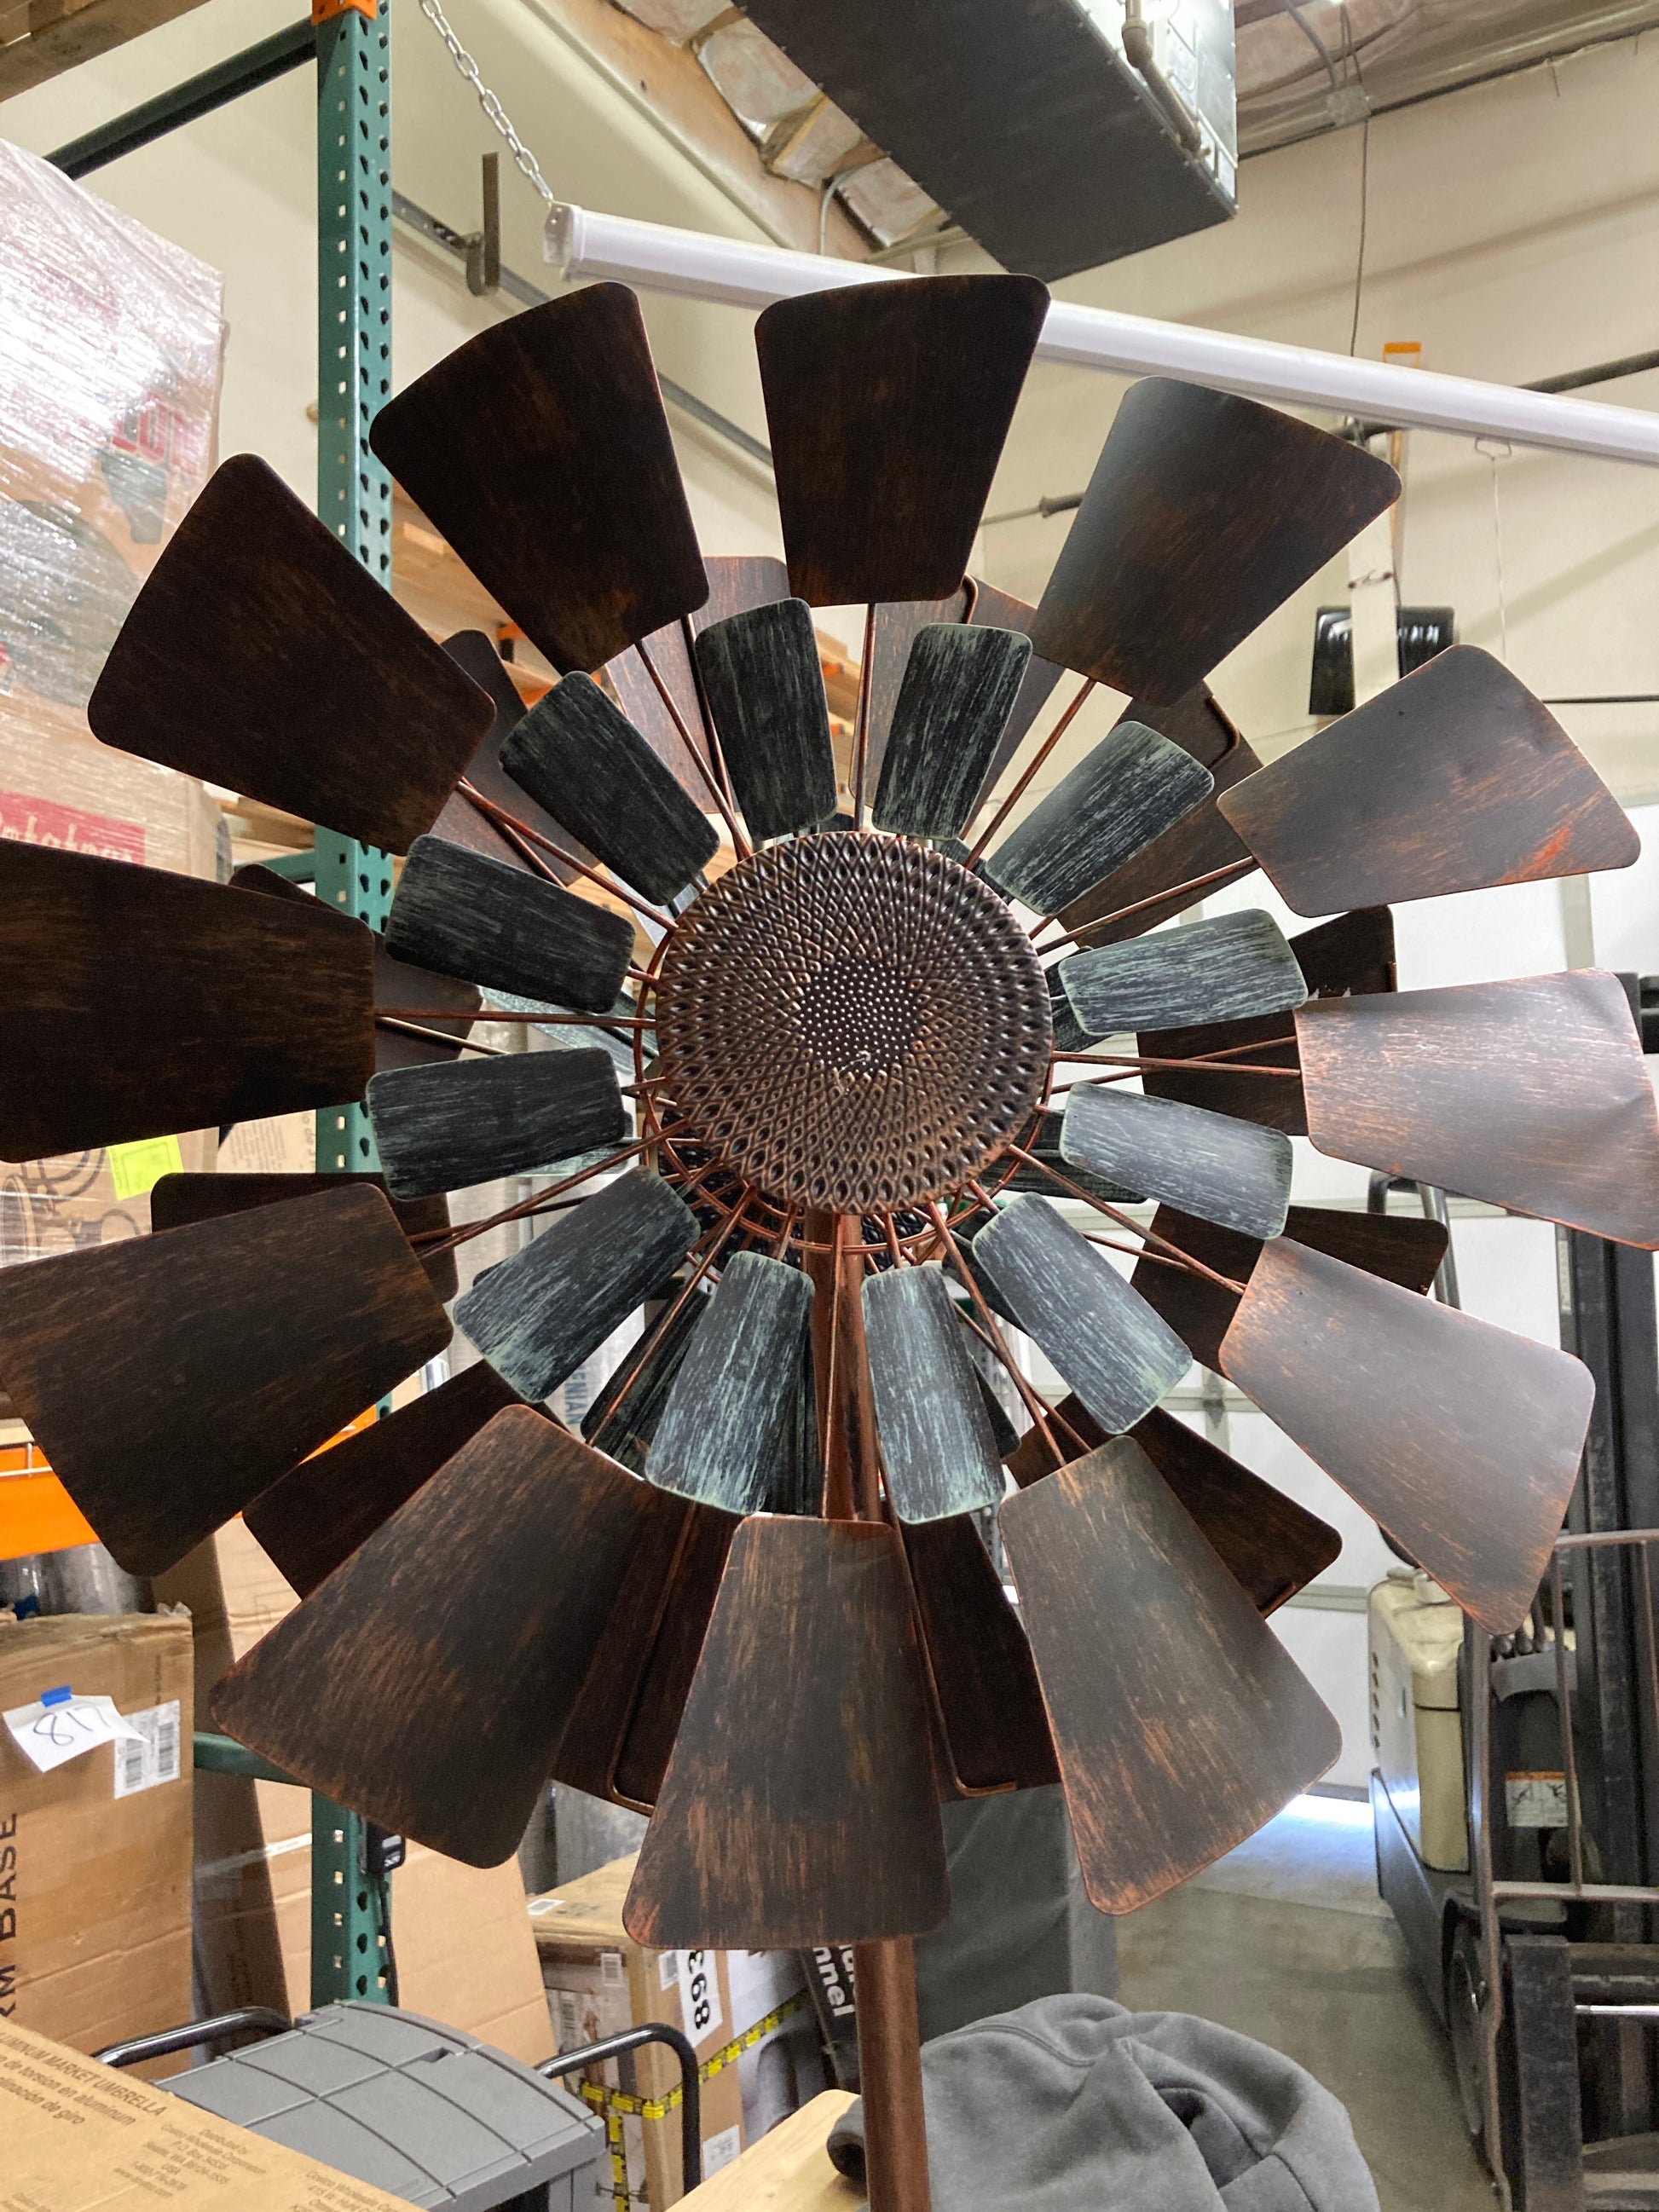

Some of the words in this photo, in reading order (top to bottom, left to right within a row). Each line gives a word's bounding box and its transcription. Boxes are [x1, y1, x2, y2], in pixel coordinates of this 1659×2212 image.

[0, 1813, 16, 1941] BASE
[689, 1949, 710, 2030] 368
[40, 2100, 62, 2112] de
[53, 2110, 86, 2125] giro
[43, 2055, 101, 2083] MARKET
[93, 2076, 168, 2117] UMBRELLA
[57, 2086, 78, 2098] en
